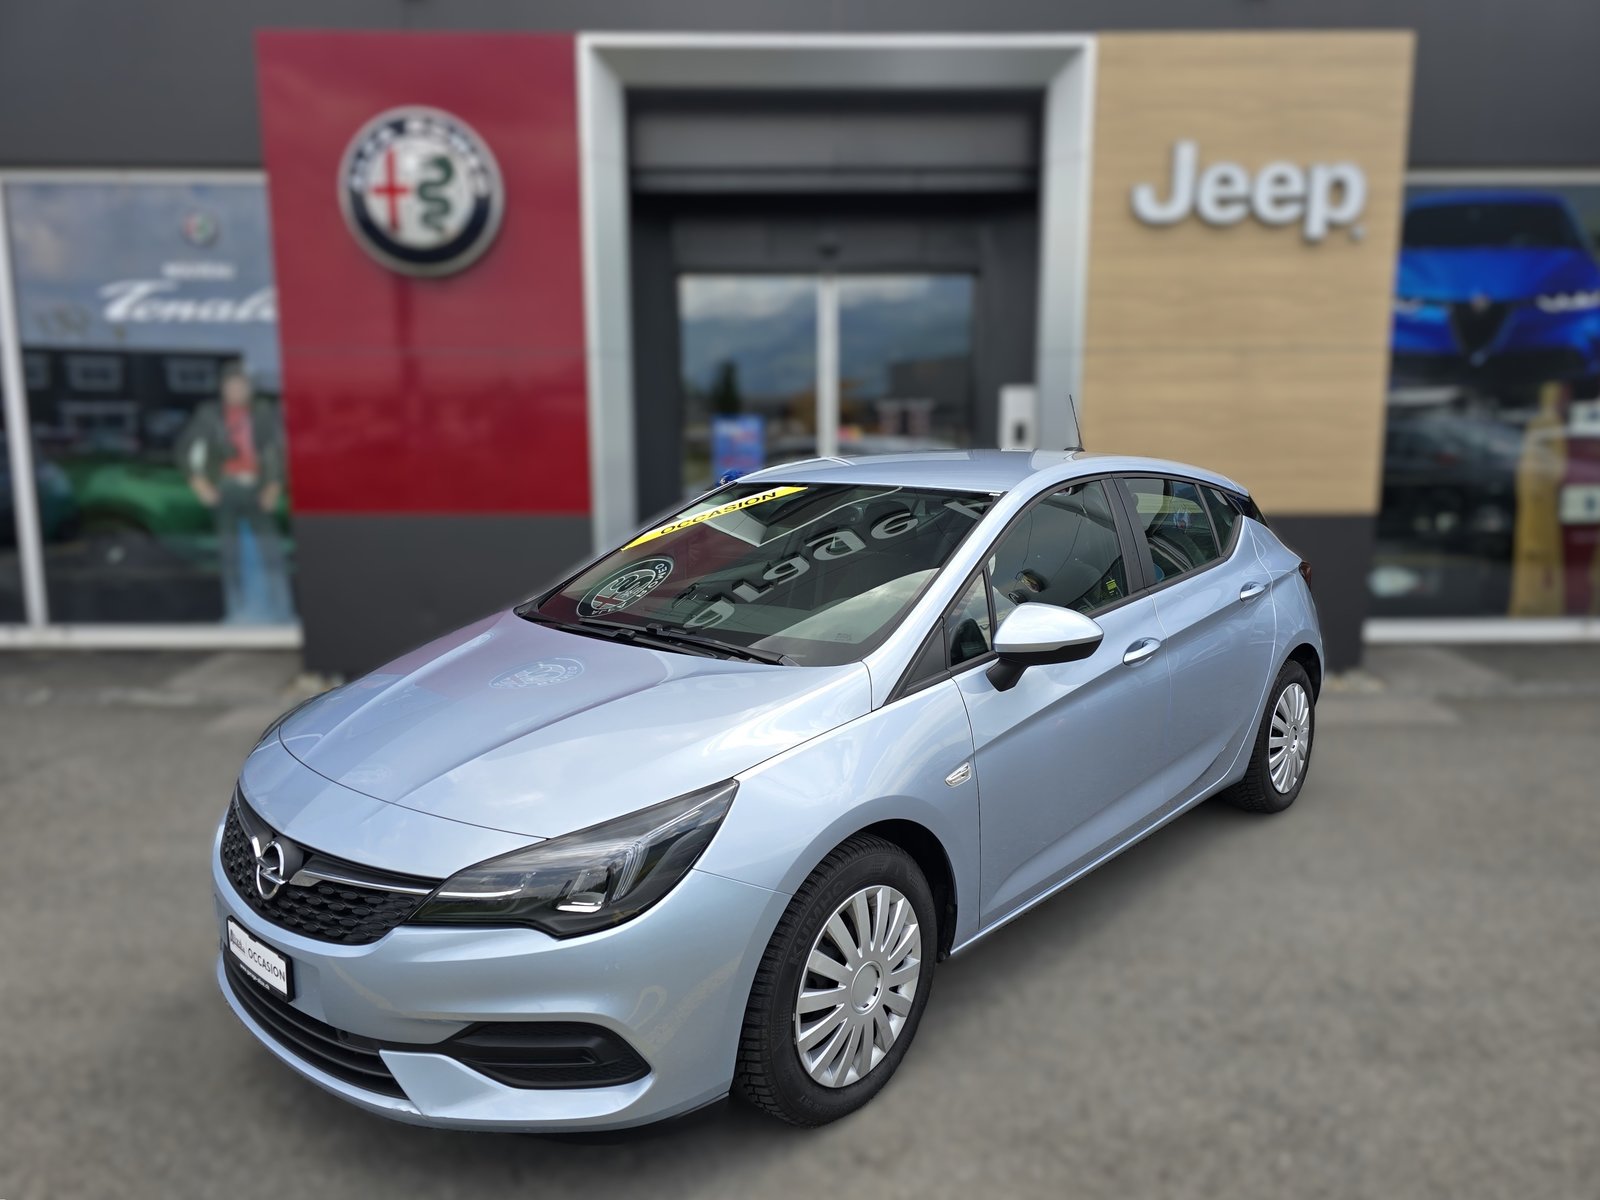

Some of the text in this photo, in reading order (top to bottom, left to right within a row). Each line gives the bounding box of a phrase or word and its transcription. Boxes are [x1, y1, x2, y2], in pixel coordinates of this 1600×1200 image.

[1131, 139, 1367, 243] Jeep
[661, 491, 777, 536] OCCASION
[248, 948, 286, 982] OCCASION
